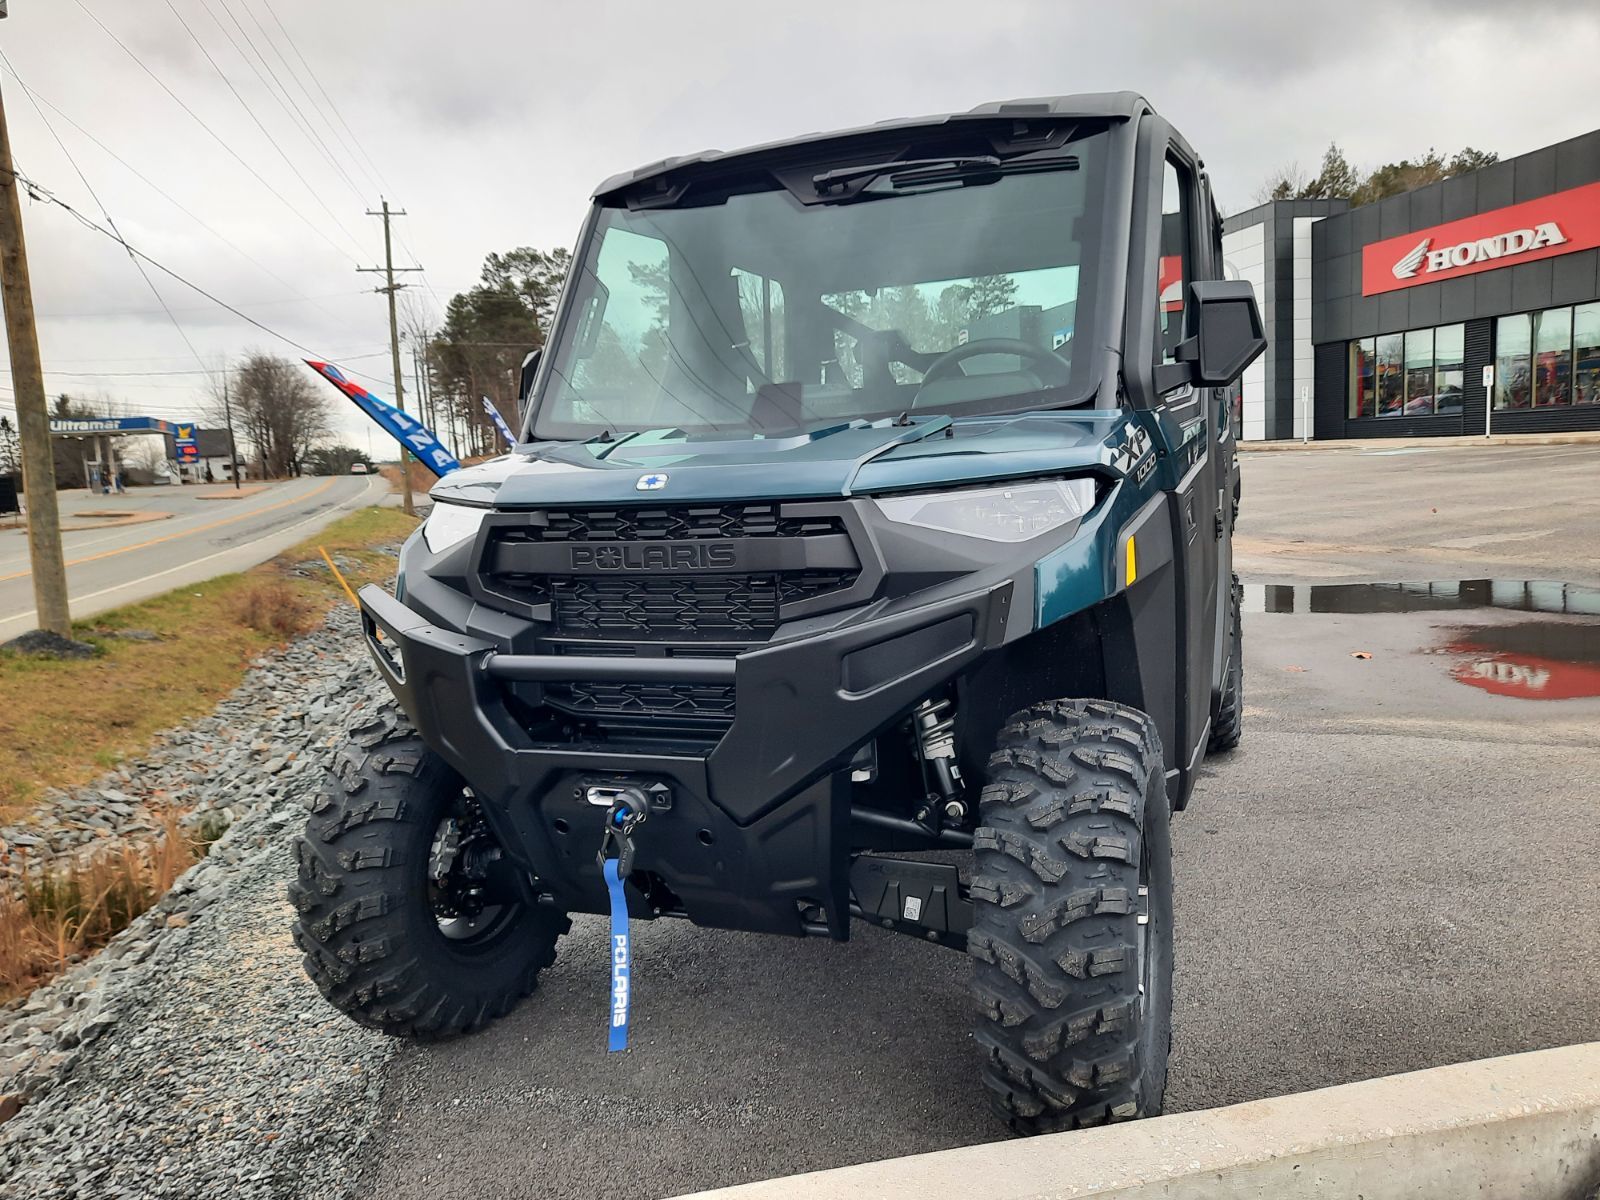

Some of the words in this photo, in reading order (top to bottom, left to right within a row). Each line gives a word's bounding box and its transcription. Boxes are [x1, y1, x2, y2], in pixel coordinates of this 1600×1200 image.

[1426, 222, 1567, 272] HONDA
[50, 420, 121, 431] Ultramar
[1119, 425, 1149, 472] XP
[1136, 452, 1157, 482] 1000
[570, 544, 737, 570] POLARIS
[613, 934, 627, 1028] POLARIS
